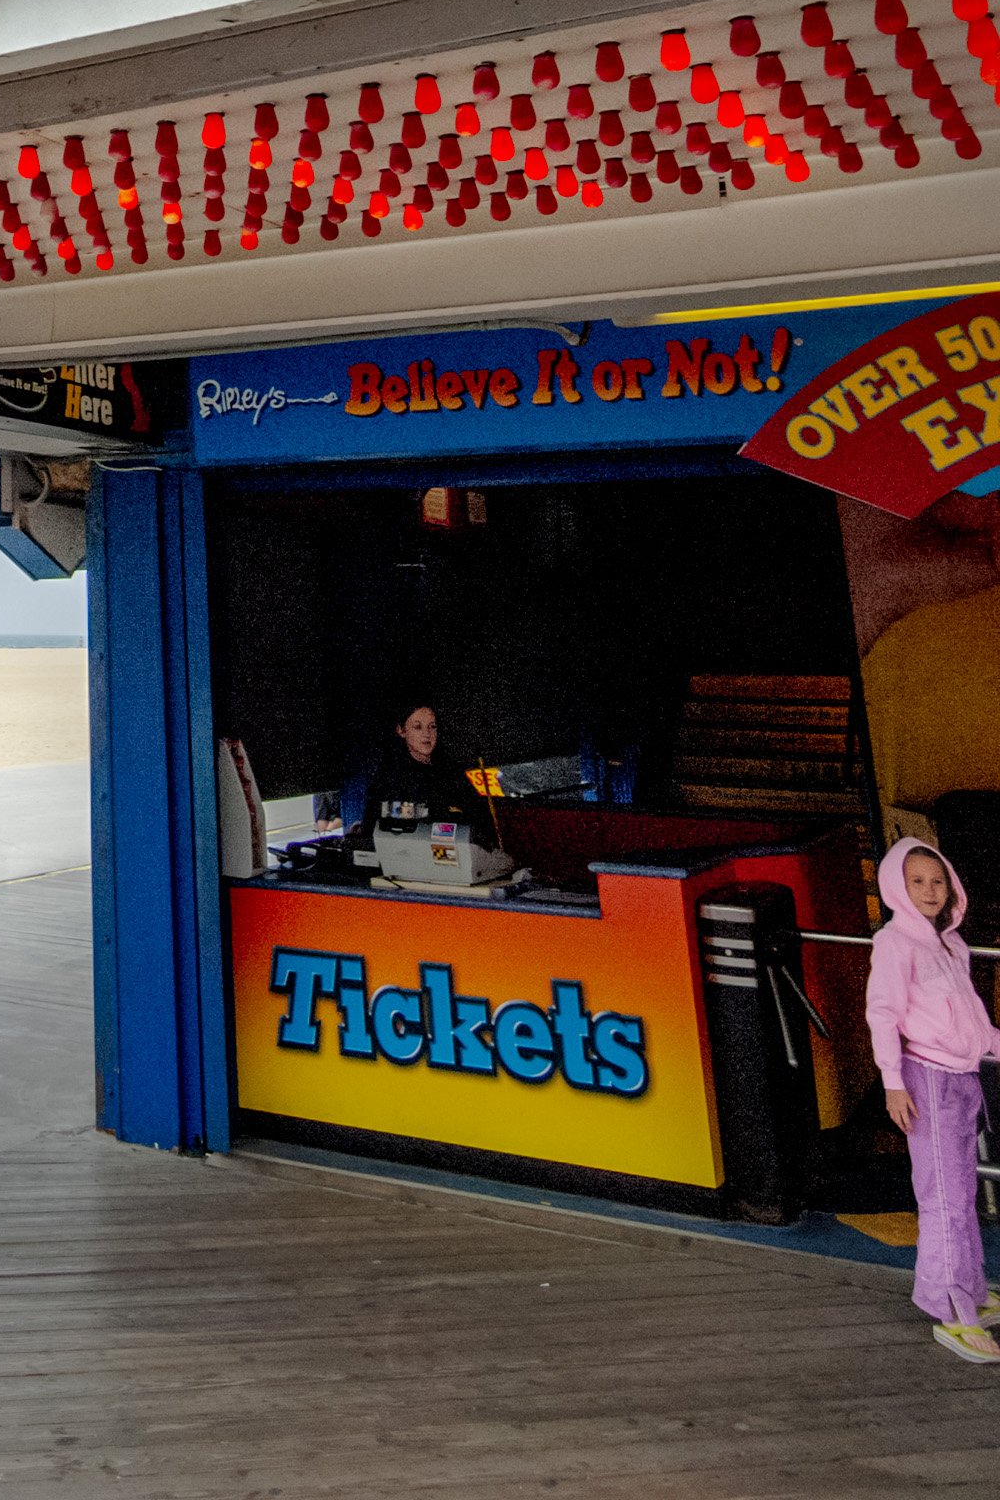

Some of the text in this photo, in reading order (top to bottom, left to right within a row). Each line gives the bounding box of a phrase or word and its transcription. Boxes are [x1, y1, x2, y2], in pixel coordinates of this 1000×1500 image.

[64, 383, 114, 426] Here
[344, 359, 519, 417] Believe
[532, 349, 581, 404] It
[591, 358, 652, 401] or
[661, 327, 790, 397] Not!
[786, 346, 940, 459] OVER
[269, 945, 649, 1098] Tickets
